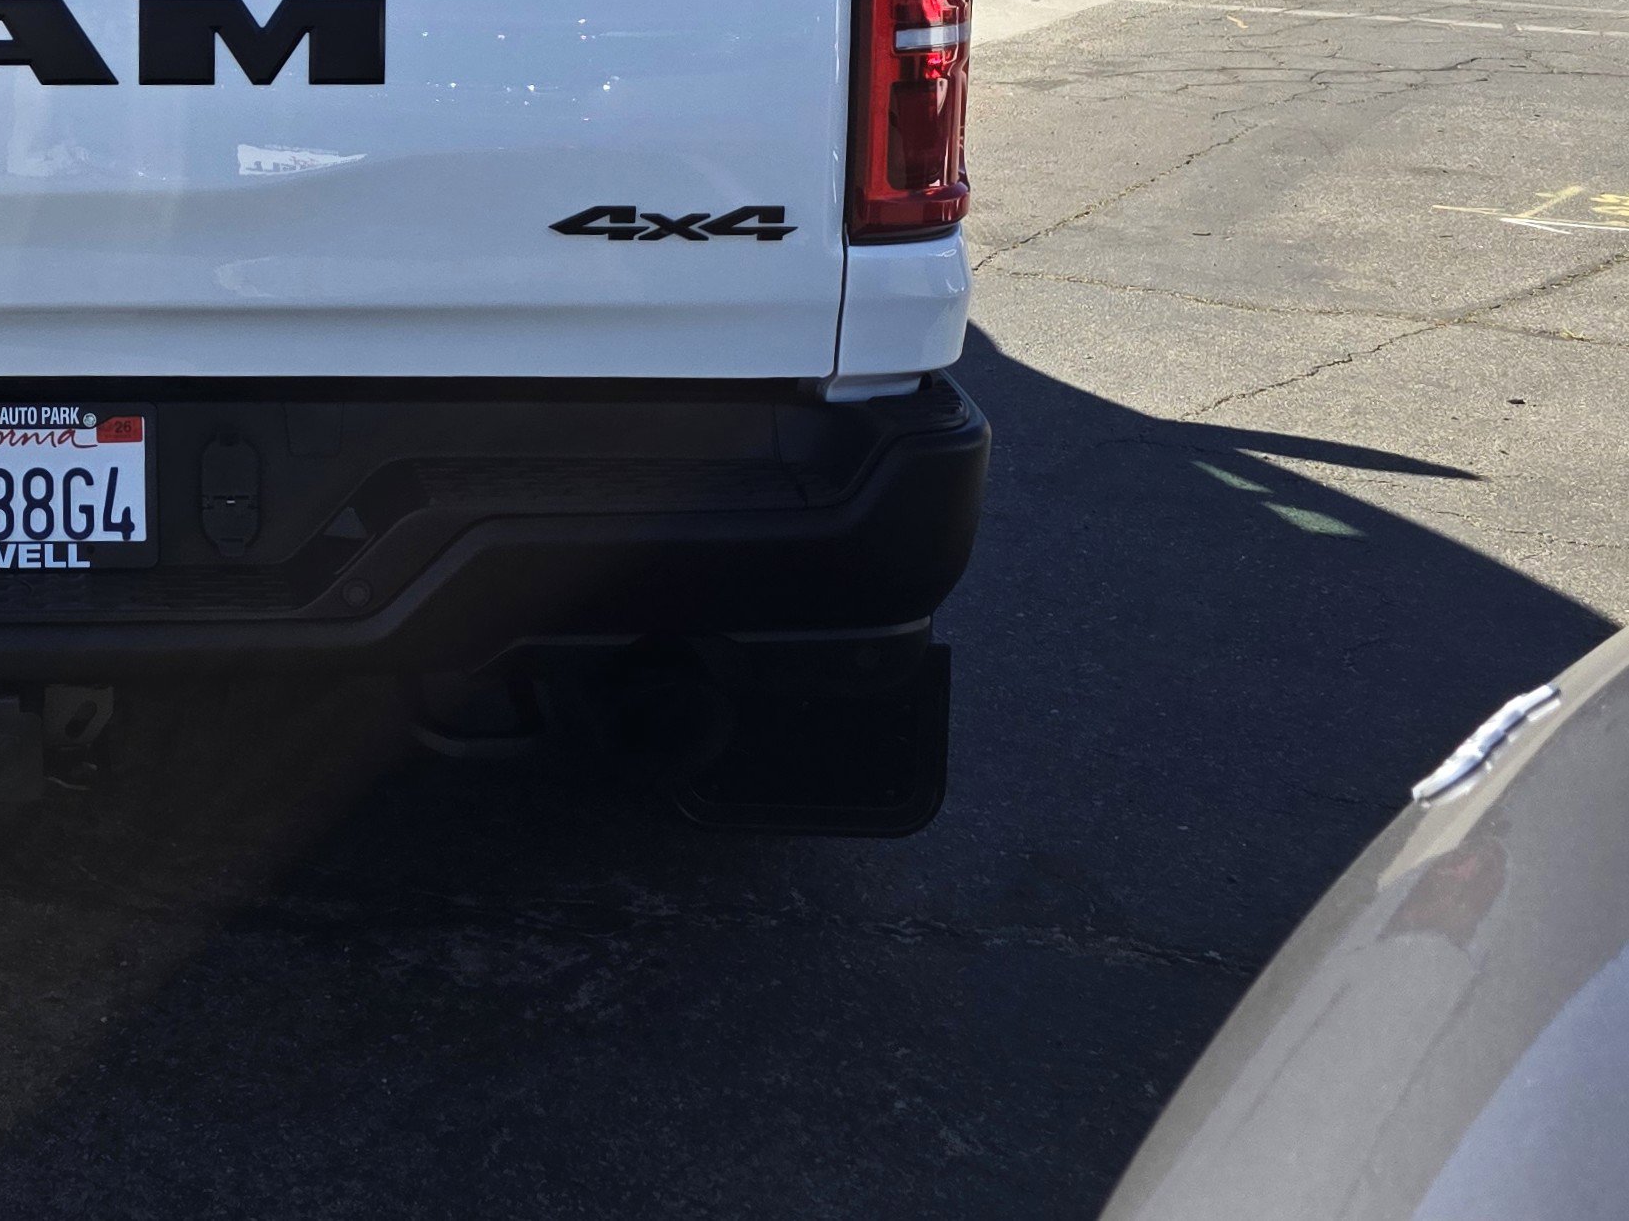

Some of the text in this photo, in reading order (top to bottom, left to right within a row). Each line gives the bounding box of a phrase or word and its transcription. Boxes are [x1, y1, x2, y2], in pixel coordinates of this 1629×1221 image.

[548, 205, 798, 241] 4x4
[0, 407, 37, 425] AUTO
[41, 406, 80, 425] PARK
[114, 420, 132, 433] 26
